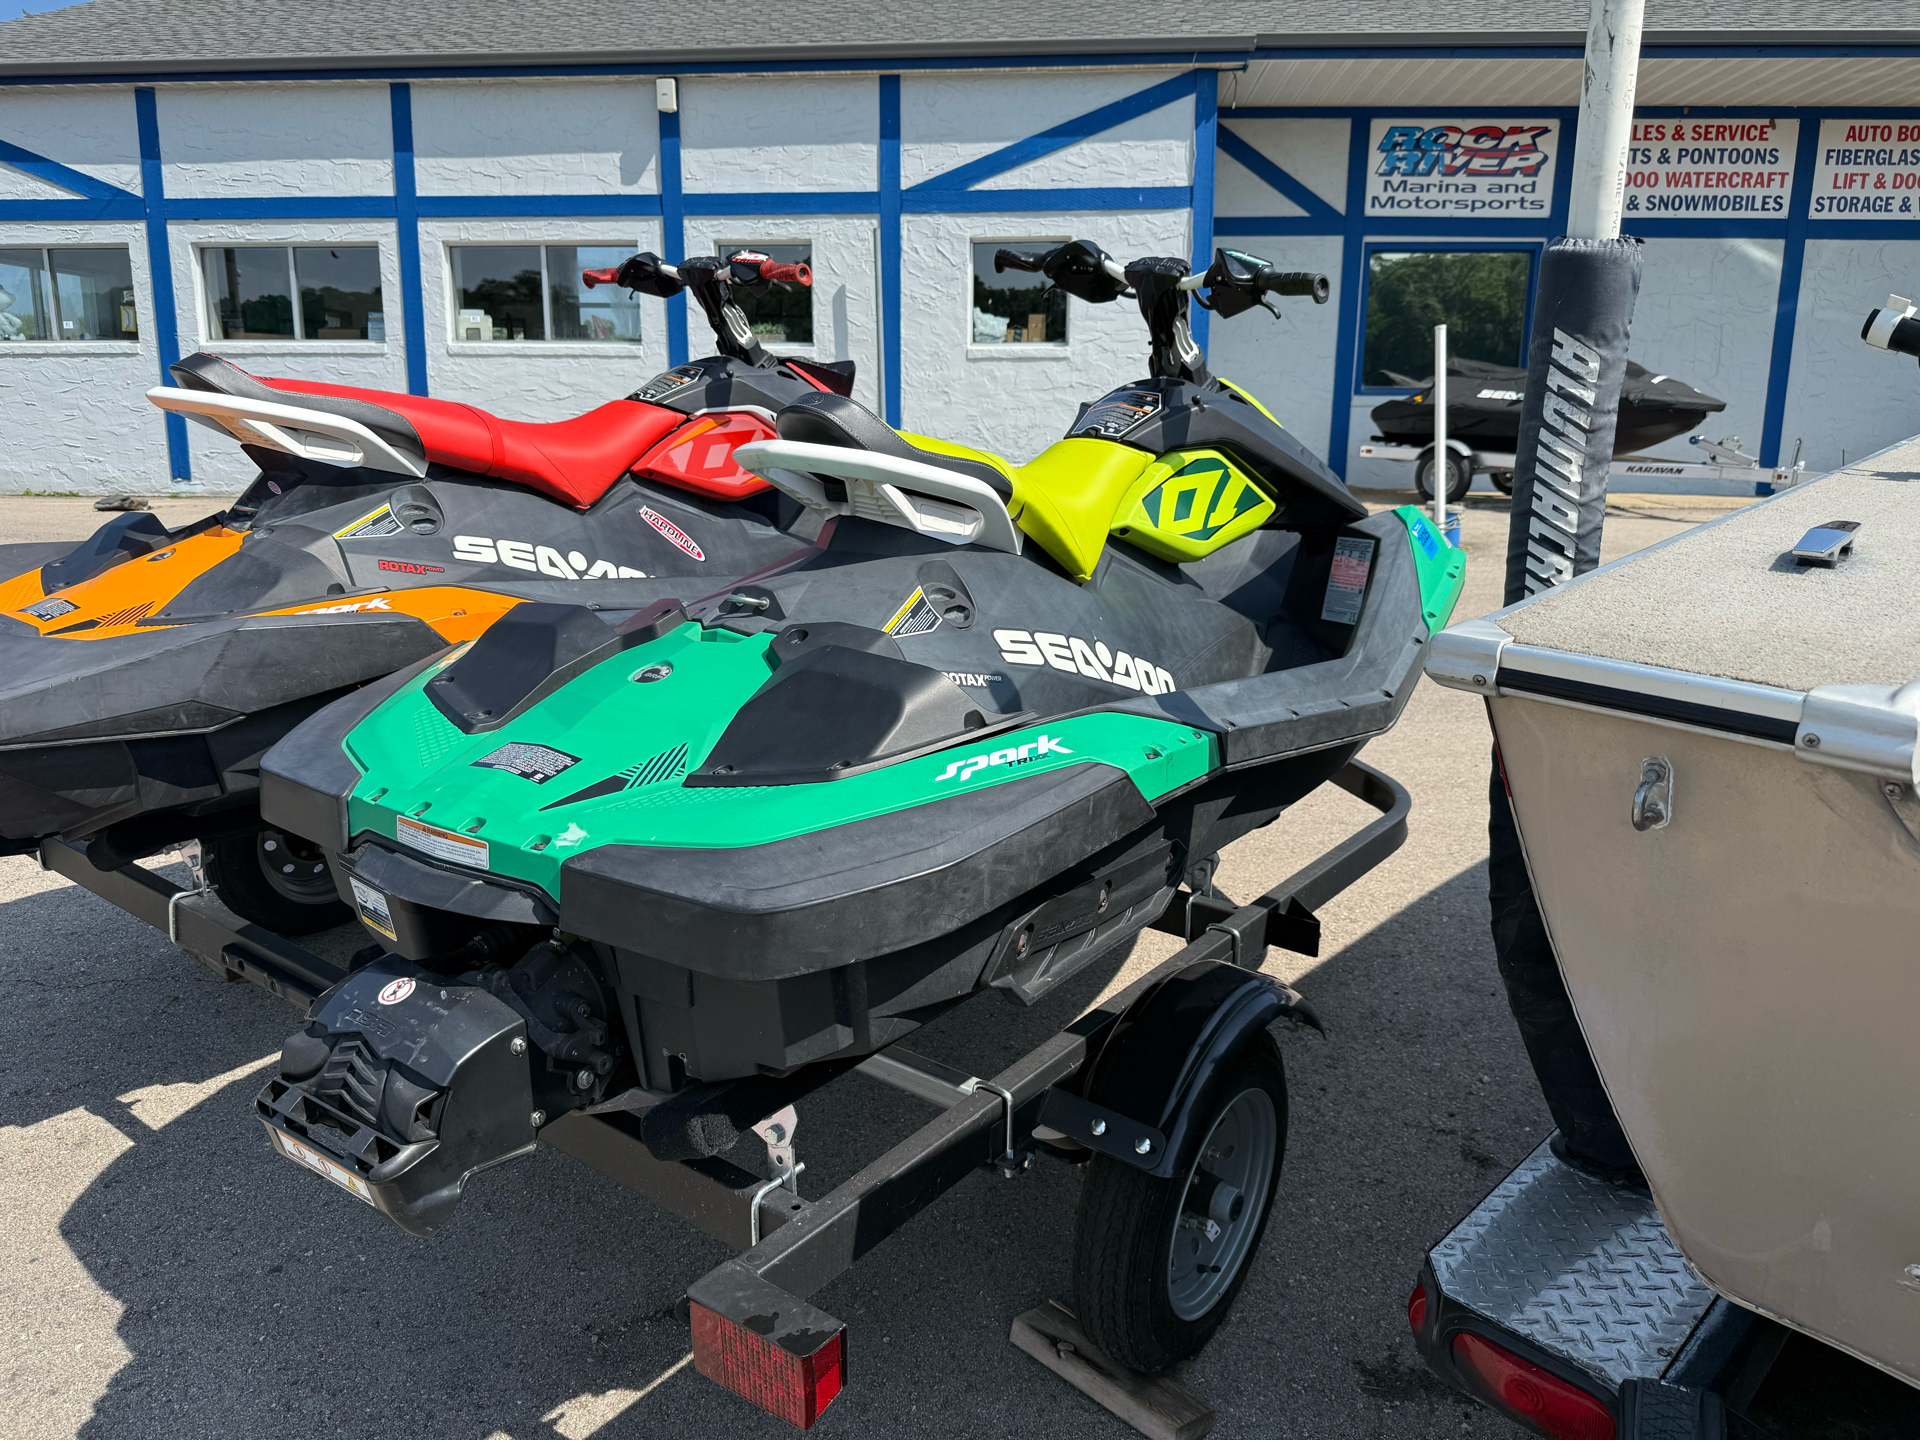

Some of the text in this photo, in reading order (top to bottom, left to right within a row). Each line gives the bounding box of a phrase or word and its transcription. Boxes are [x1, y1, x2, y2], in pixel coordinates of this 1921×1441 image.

[1377, 126, 1551, 151] ROCK
[1631, 124, 1771, 142] LES & SERVICE
[1845, 125, 1892, 142] AUTO
[1375, 150, 1549, 177] RIVER
[1627, 148, 1780, 165] TS & PONTOONS
[1383, 180, 1537, 194] Marina and
[1665, 171, 1790, 189] WATERCRAFT
[1832, 172, 1920, 190] LIFT & DO
[1371, 196, 1544, 212] Motorsports
[1626, 195, 1784, 212] & SNOWMOBILES
[1814, 195, 1912, 213] STORAGE &
[1626, 465, 1684, 475] KARAVAN
[644, 510, 700, 555] HARDLINE
[379, 560, 427, 575] ROTAX
[985, 674, 1003, 682] POWER
[935, 734, 1074, 782] spark
